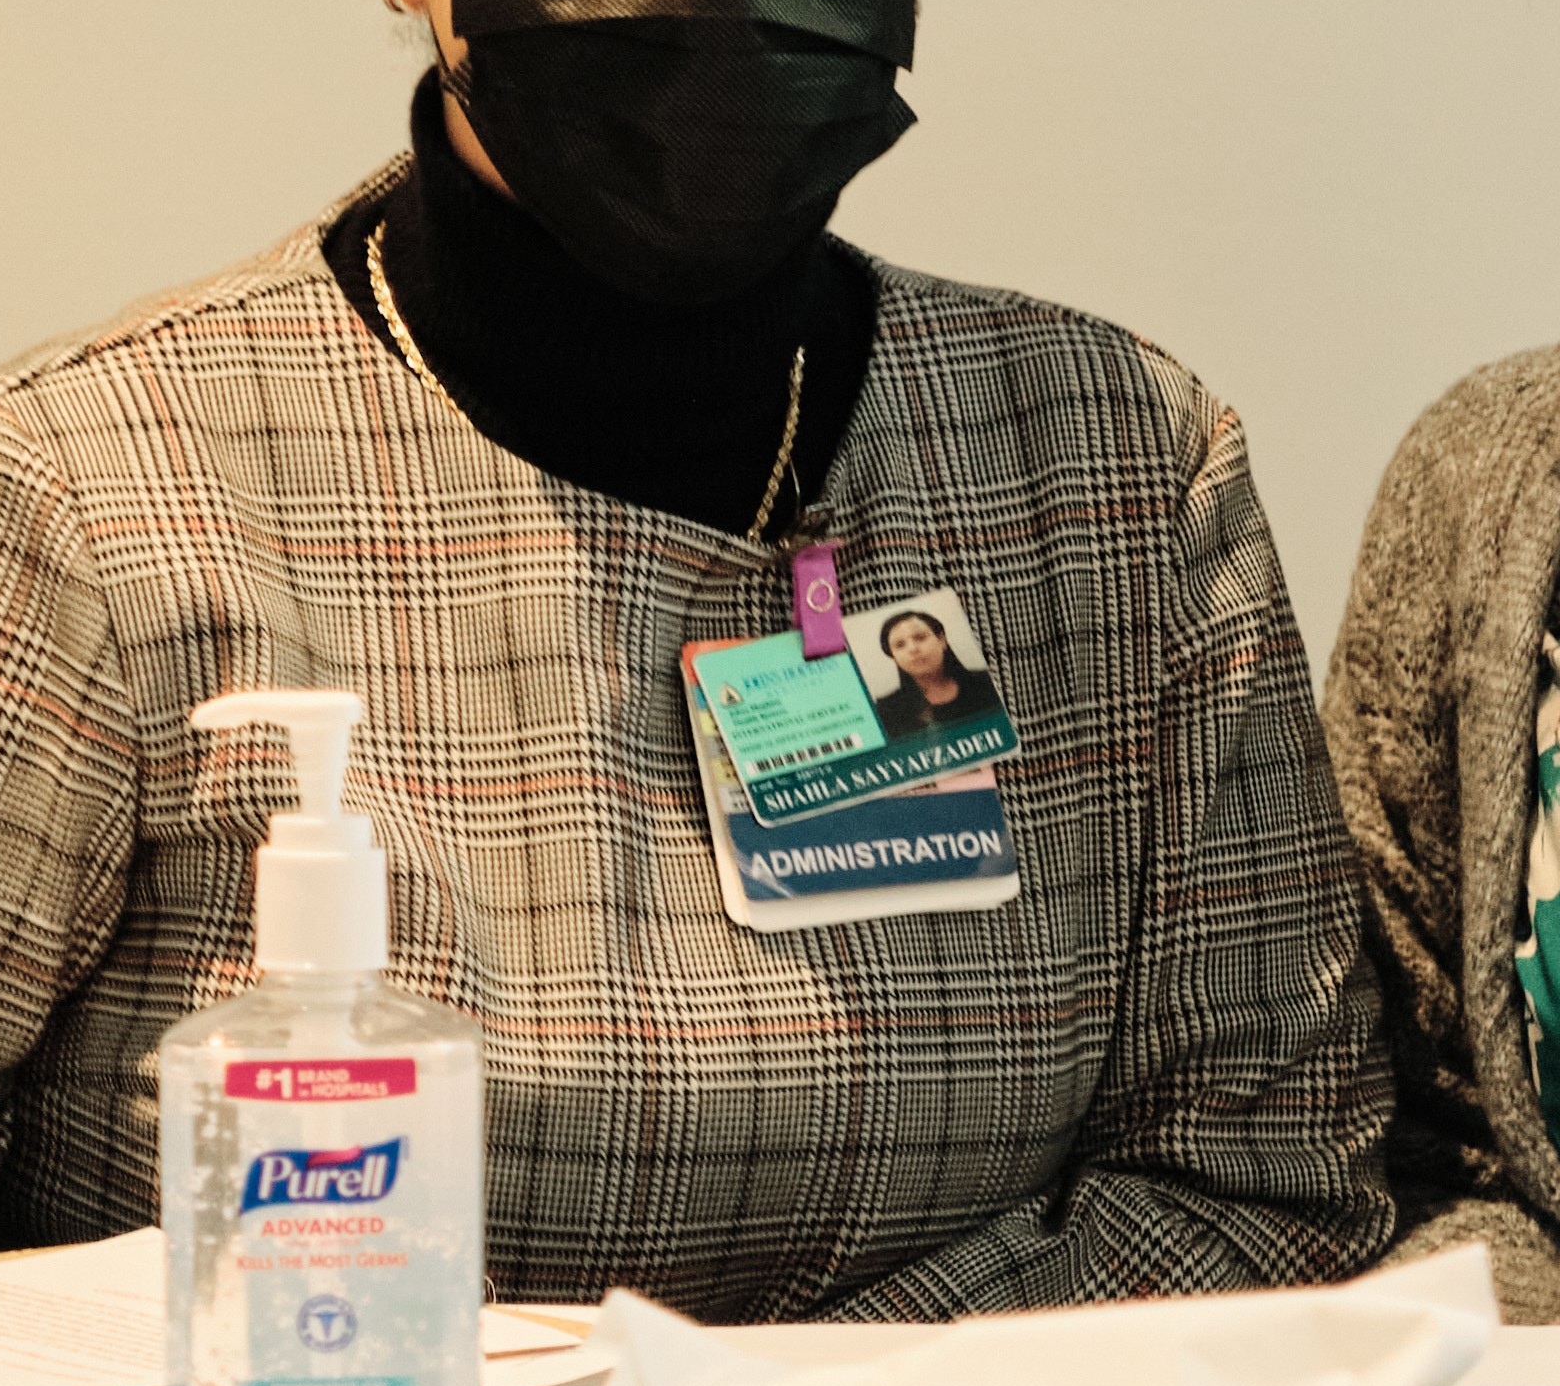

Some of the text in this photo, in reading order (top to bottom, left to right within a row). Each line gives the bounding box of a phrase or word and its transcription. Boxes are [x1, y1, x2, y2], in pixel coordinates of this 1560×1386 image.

[765, 779, 851, 813] SHAHLA
[751, 830, 1003, 879] ADMINISTRATION
[255, 1068, 293, 1098] #1
[257, 1154, 388, 1200] Purell
[261, 1217, 385, 1236] ADVANCED
